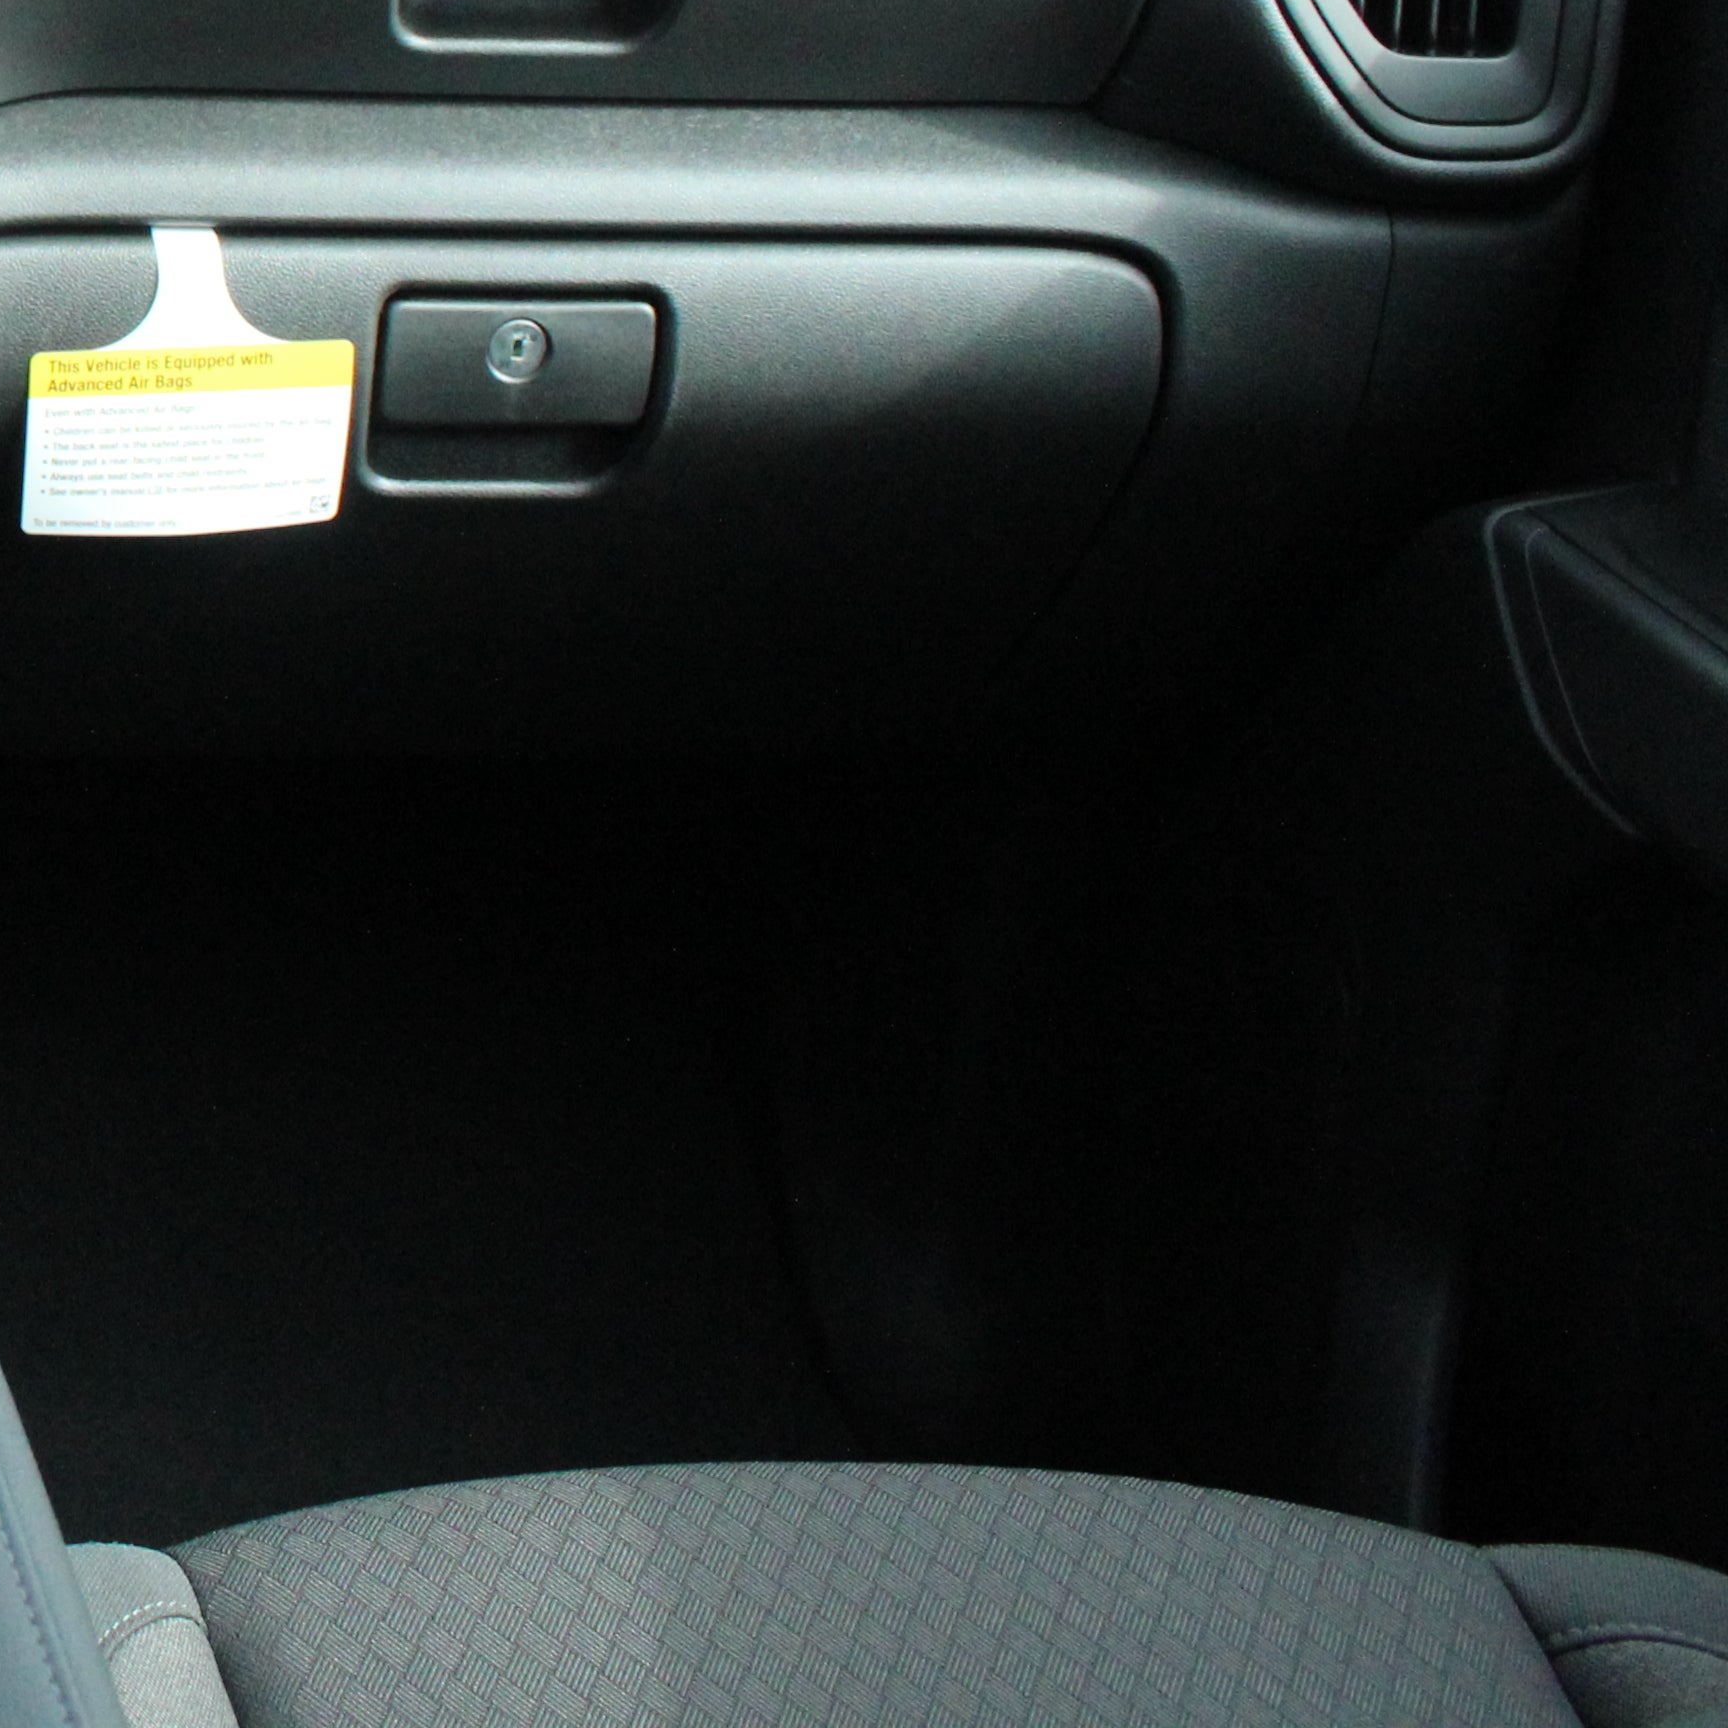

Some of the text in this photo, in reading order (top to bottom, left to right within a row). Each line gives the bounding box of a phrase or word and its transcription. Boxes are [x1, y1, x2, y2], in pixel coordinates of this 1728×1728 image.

[49, 351, 273, 374] This Vehicle is Equipped with
[47, 374, 193, 393] Advanced Air Bags
